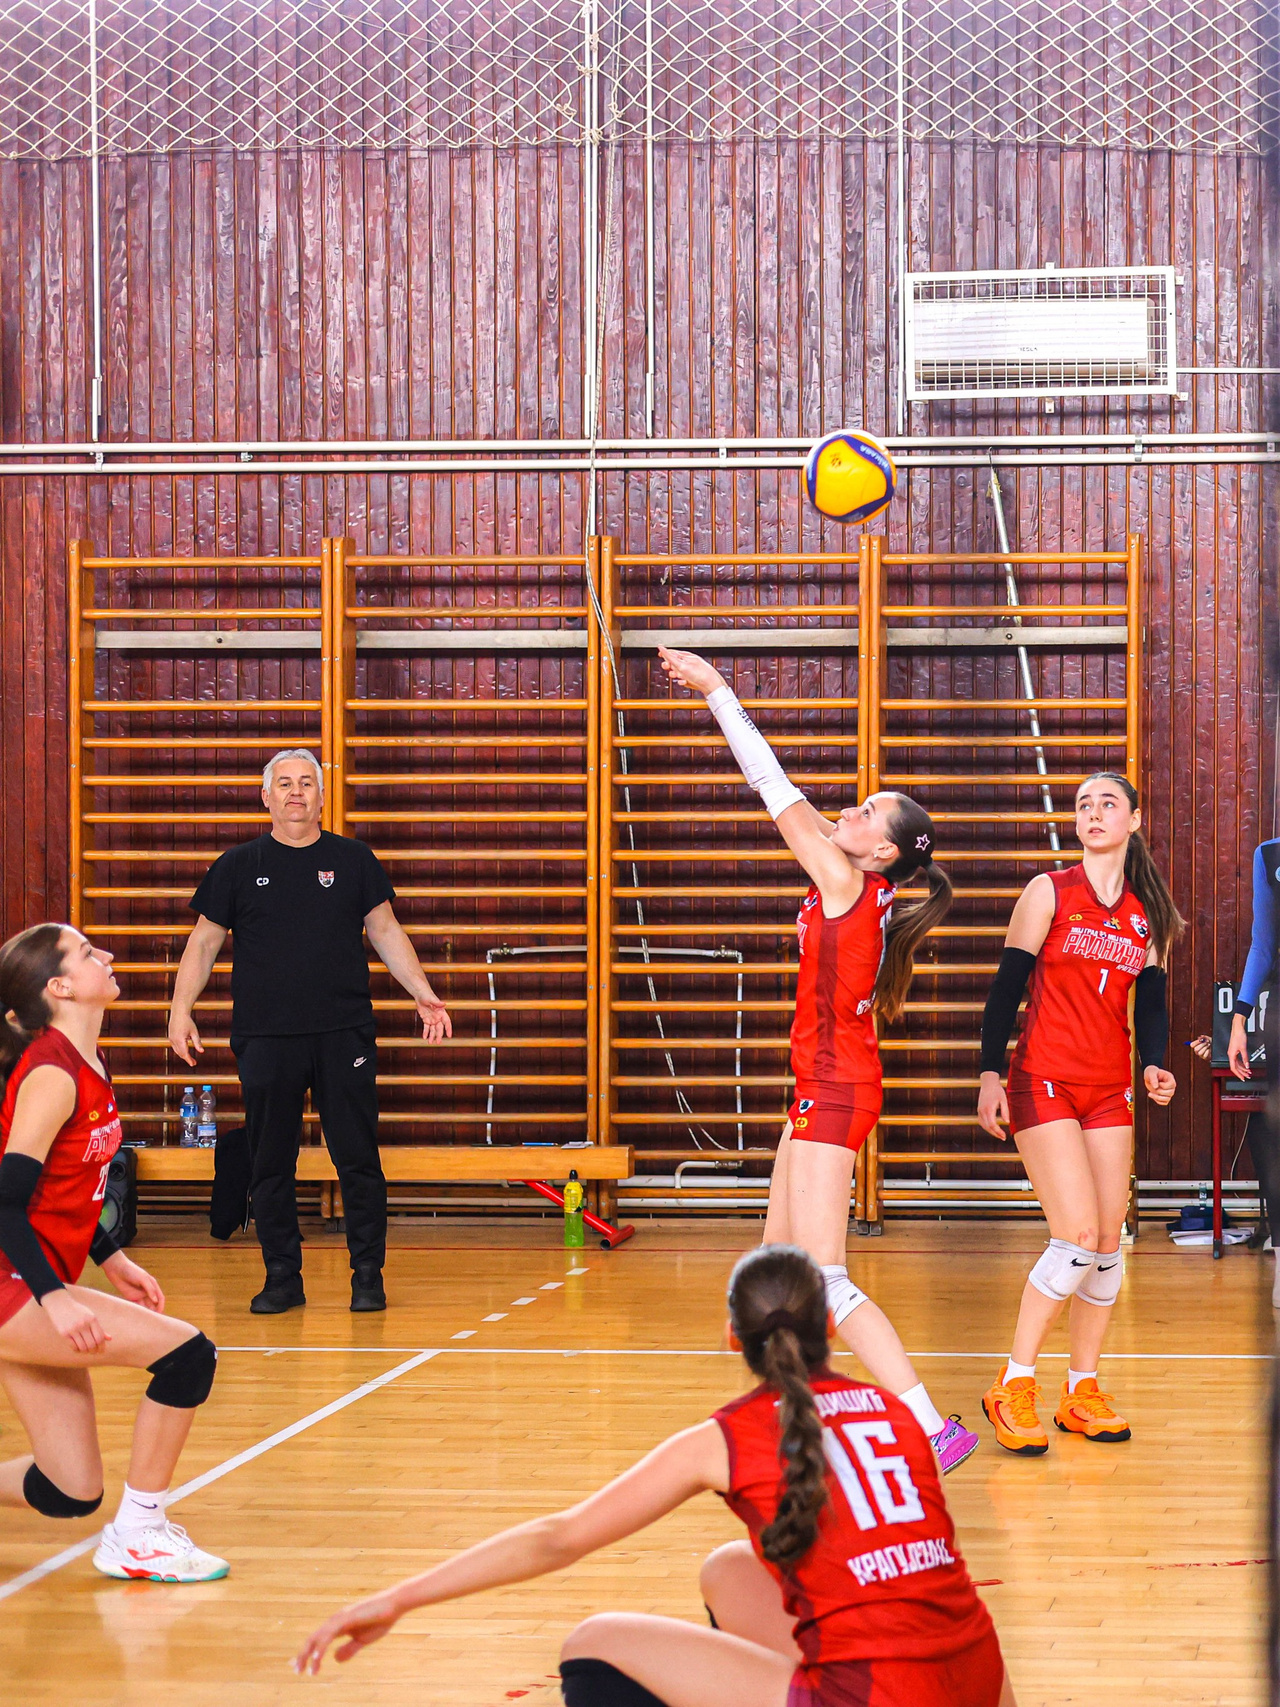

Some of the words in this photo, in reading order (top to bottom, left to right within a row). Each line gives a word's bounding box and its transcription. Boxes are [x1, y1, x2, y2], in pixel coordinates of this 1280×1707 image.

[1098, 967, 1110, 996] 1
[1218, 987, 1234, 1014] 0
[820, 1420, 927, 1532] 16
